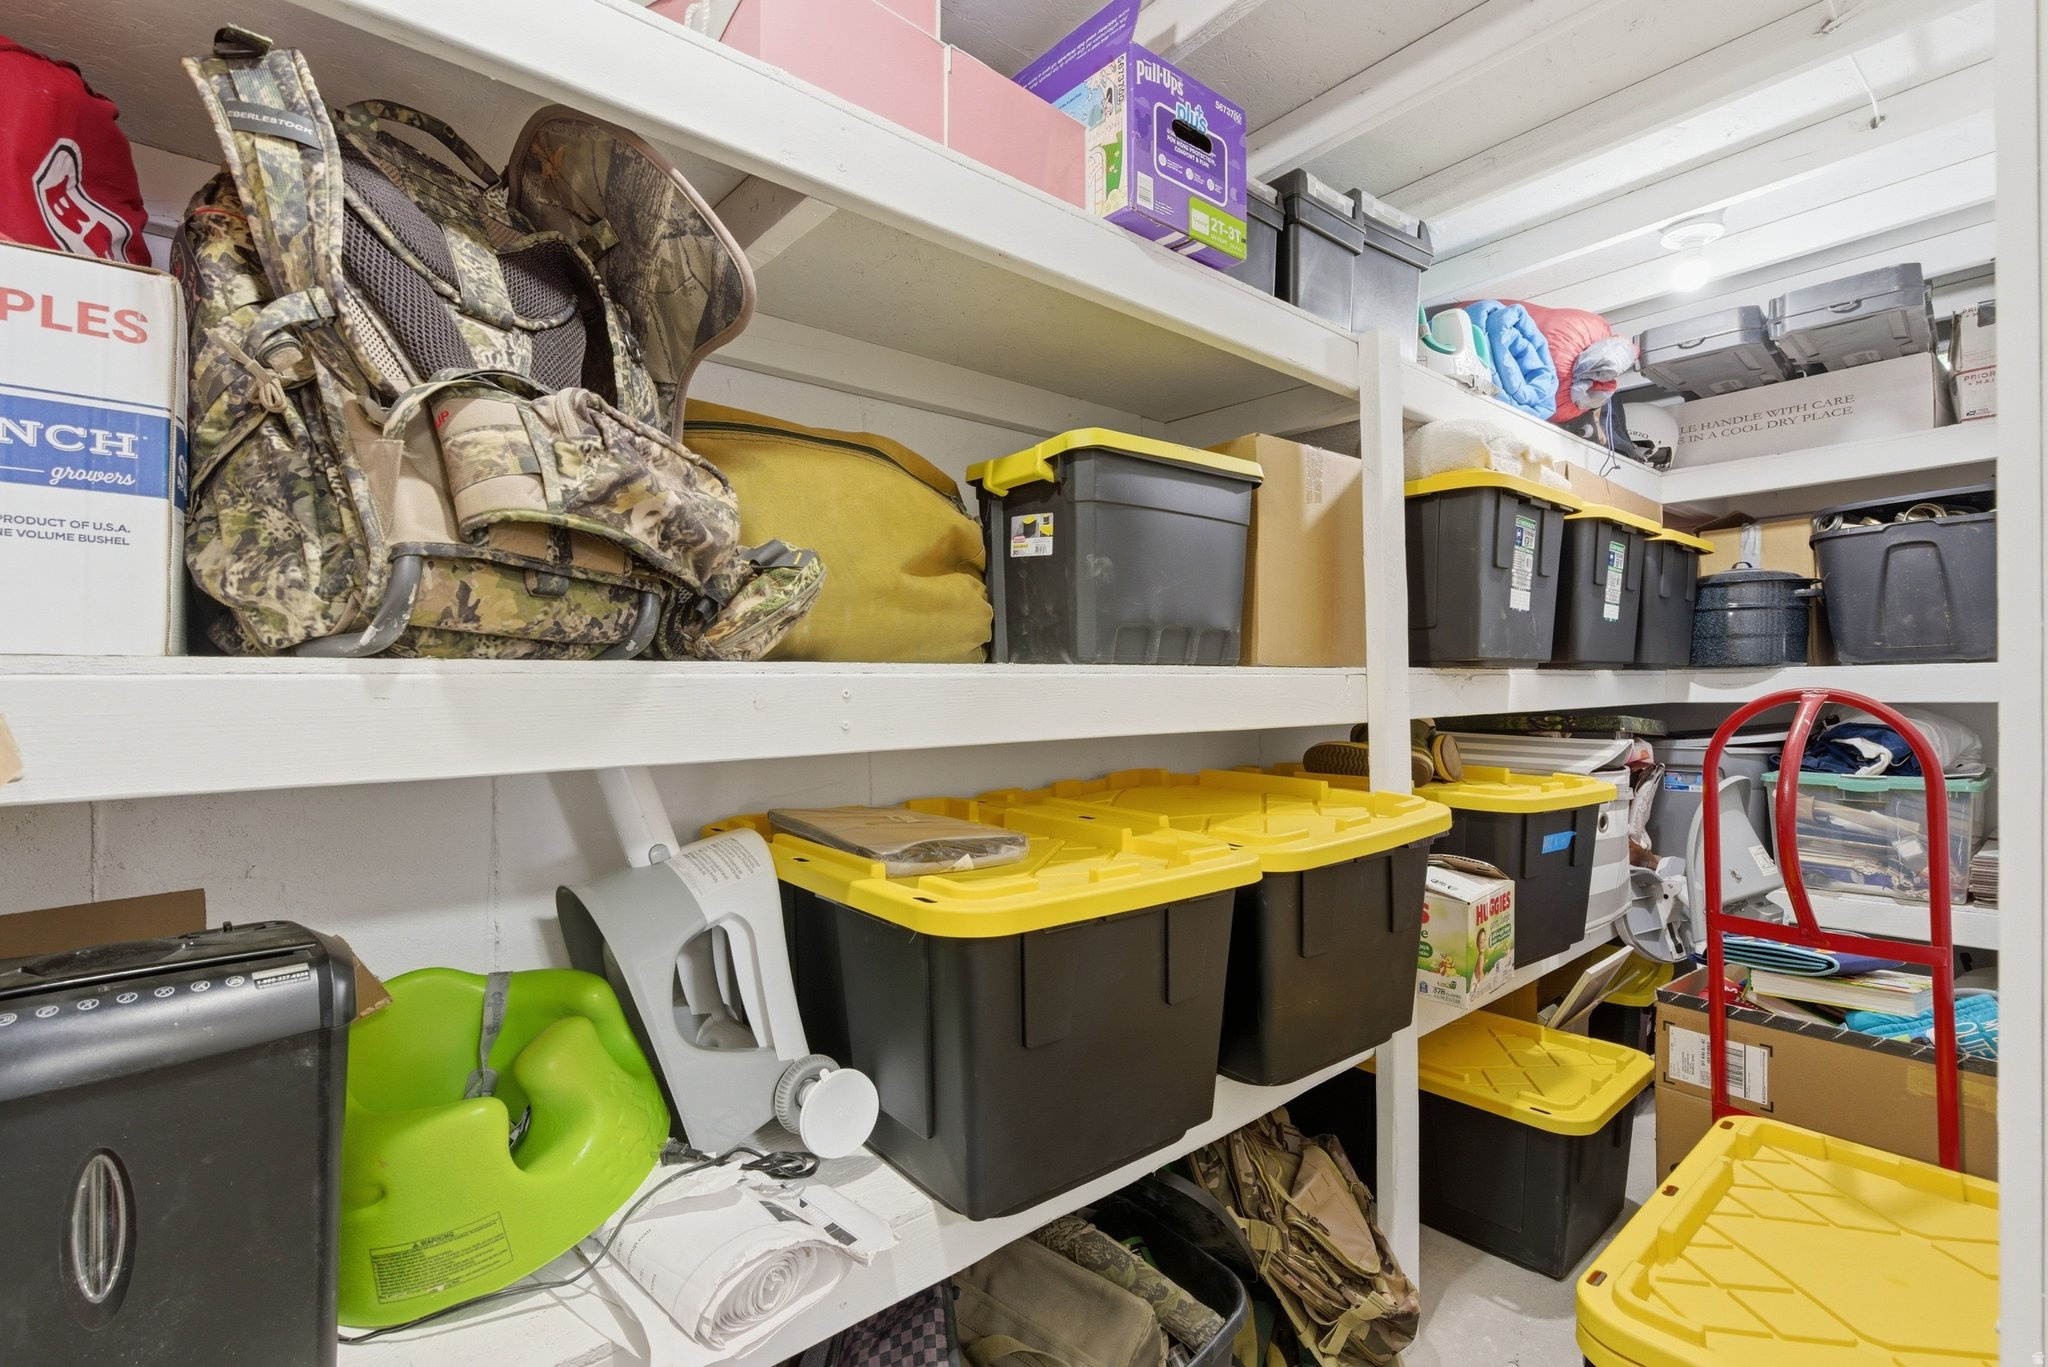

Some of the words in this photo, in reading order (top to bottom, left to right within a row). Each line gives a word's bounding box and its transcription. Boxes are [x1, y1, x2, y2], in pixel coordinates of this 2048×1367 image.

[226, 110, 314, 136] EBERLESTOCK
[1210, 217, 1242, 244] 2T-3T
[0, 286, 149, 345] PLES
[1689, 433, 1704, 444] IN
[1708, 432, 1718, 440] A
[1721, 424, 1763, 437] COOL
[1767, 416, 1799, 429] DRY
[1802, 406, 1854, 423] PLACE
[1700, 412, 1762, 432] HANDLE
[1766, 402, 1808, 418] WITH
[1811, 394, 1856, 410] CARE
[0, 418, 138, 459] NCH
[49, 465, 136, 486] growers
[16, 528, 75, 543] VOLUME
[78, 532, 130, 546] BUSHEL
[70, 518, 90, 530] OF
[93, 521, 131, 534] U.S.A.
